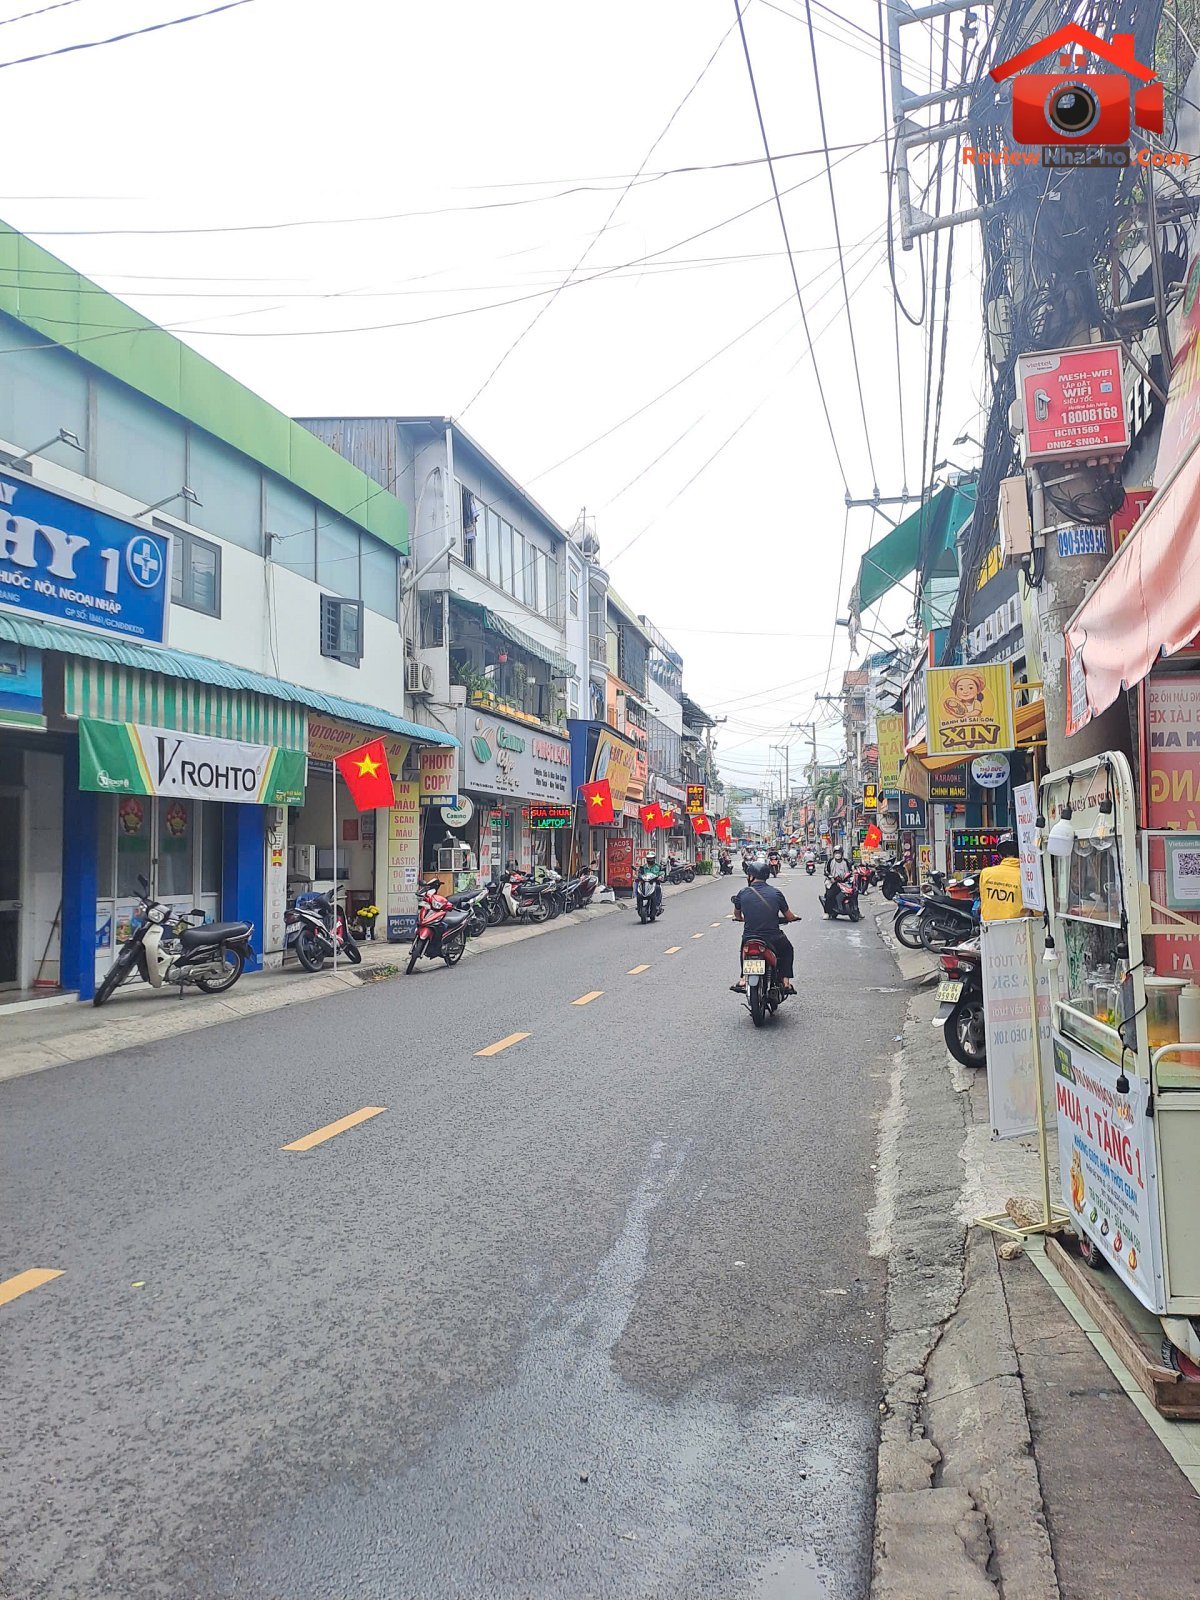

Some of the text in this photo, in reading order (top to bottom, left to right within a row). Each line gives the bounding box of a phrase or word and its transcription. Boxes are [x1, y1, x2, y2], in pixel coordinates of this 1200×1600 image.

[1026, 360, 1053, 369] viettel
[1058, 368, 1113, 382] MESH-WIFI
[1062, 387, 1092, 398] WIFI
[1060, 406, 1118, 425] 18008168
[101, 547, 120, 594] 1
[95, 596, 122, 615] NHẬP
[421, 754, 455, 770] PHOTO
[424, 775, 452, 791] COPY
[934, 774, 961, 783] KARAOKE
[399, 784, 410, 794] IN
[394, 798, 416, 810] MÀU
[394, 815, 415, 824] SCAN
[537, 818, 566, 827] LAPTOP
[904, 811, 921, 825] TRÀ
[986, 887, 1015, 904] TADA
[1056, 1081, 1084, 1133] MUA
[1094, 1107, 1133, 1176] TẶNG
